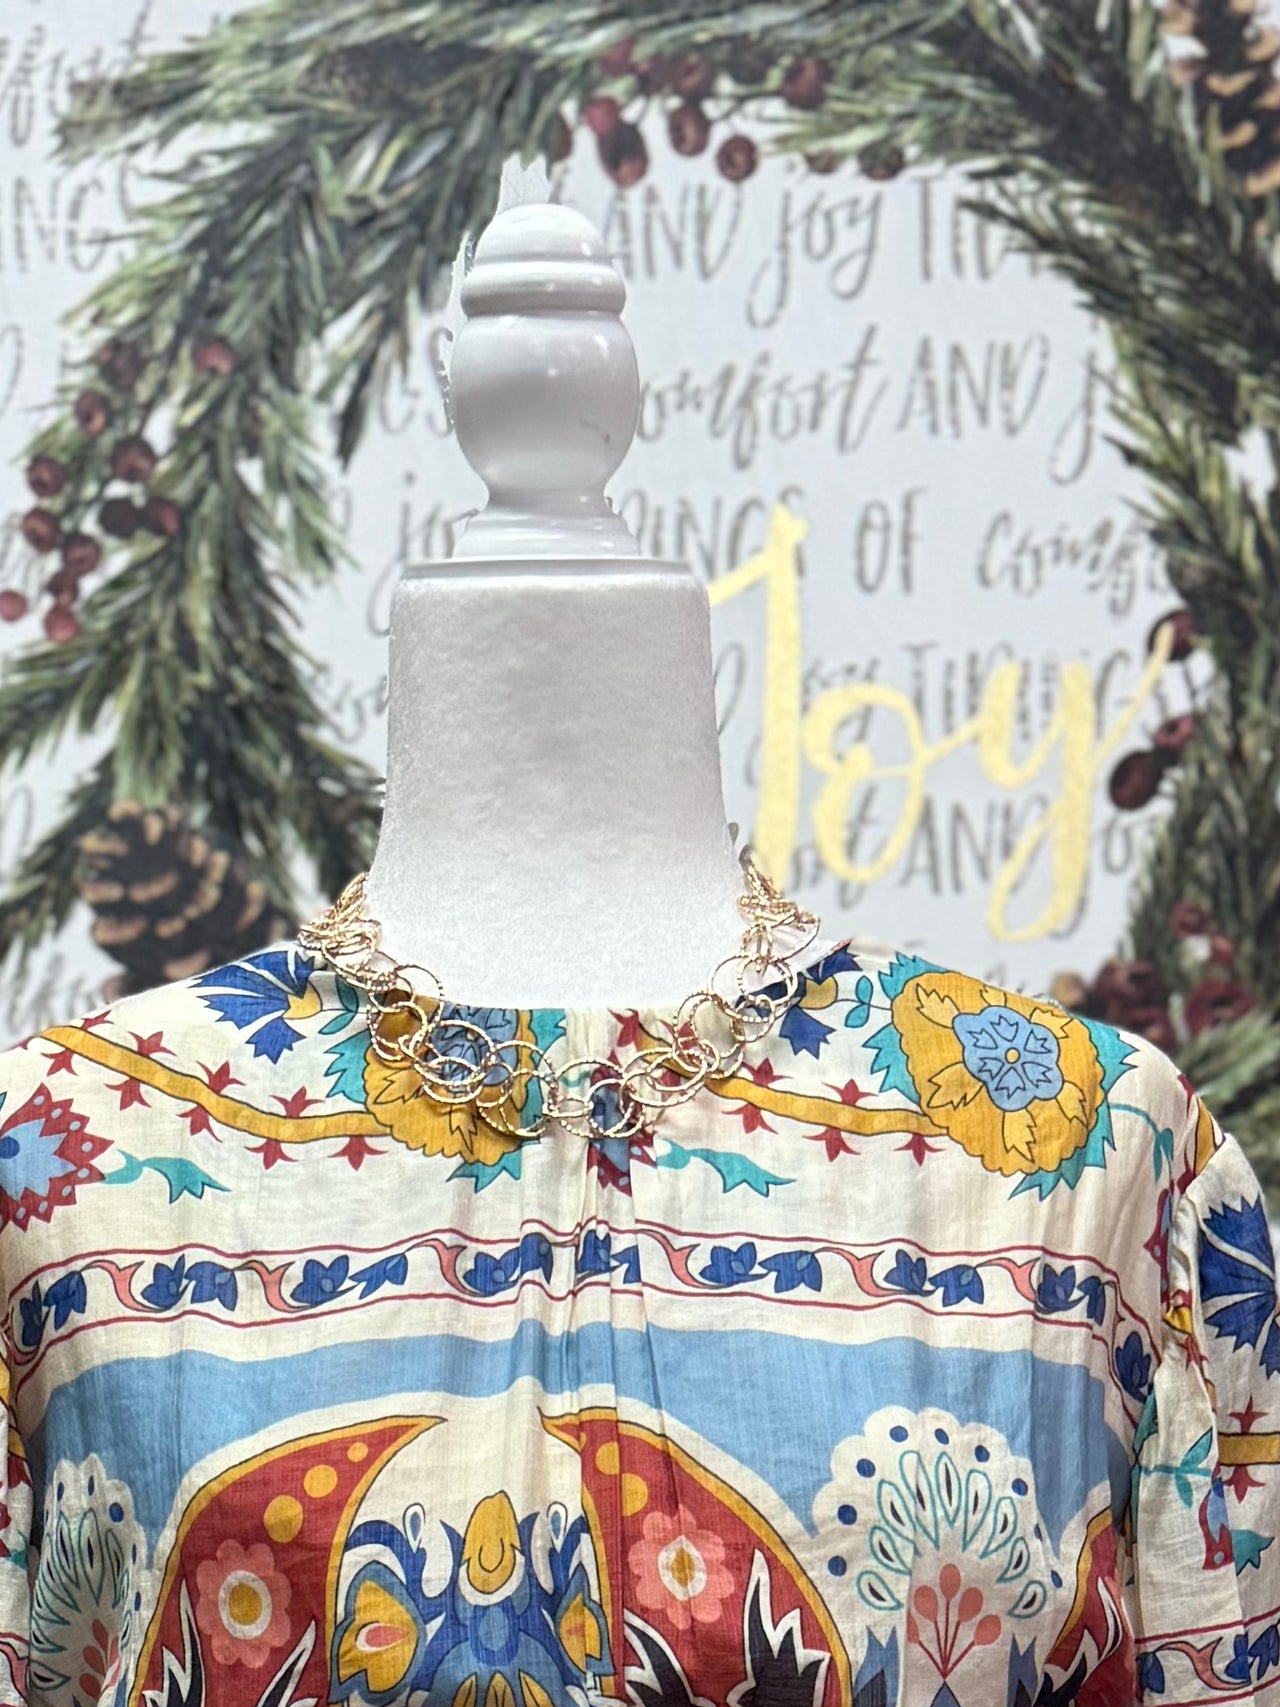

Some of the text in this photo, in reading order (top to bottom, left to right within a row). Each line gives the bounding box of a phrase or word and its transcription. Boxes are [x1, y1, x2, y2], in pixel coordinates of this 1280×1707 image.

[746, 160, 882, 329] joy
[638, 325, 890, 470] omfort
[897, 335, 1050, 440] AND
[854, 486, 927, 596] OF
[708, 500, 1177, 943] Joy
